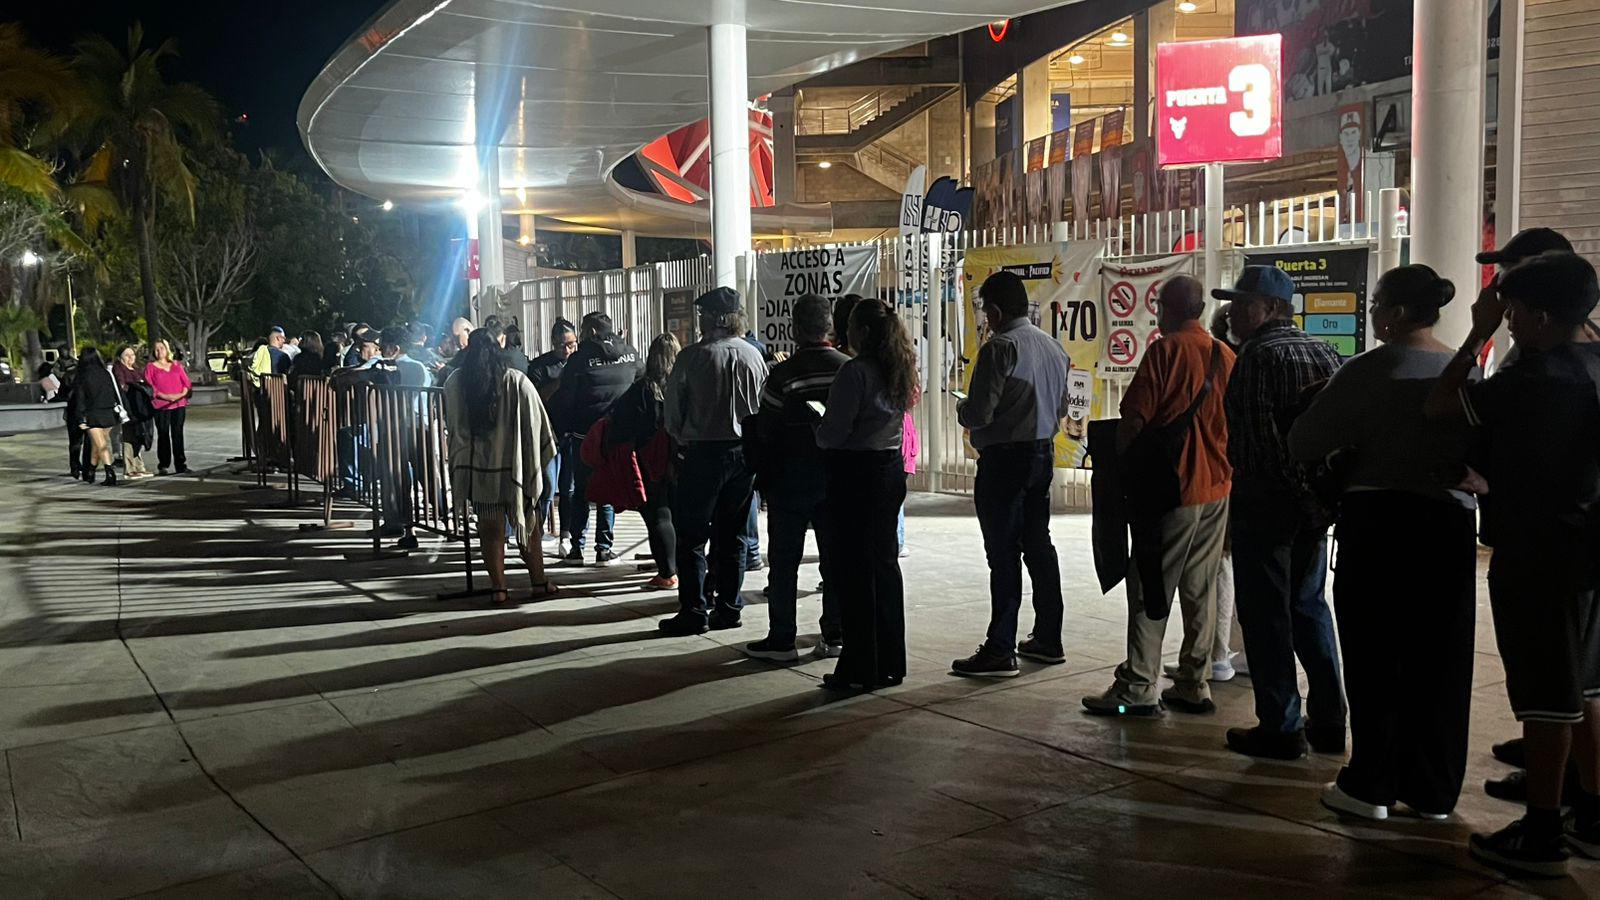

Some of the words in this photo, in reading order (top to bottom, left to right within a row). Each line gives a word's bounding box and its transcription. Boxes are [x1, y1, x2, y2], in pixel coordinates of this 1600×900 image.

[1166, 86, 1227, 107] PUERTA
[1228, 63, 1272, 137] 3
[780, 249, 830, 271] ACCESO
[834, 248, 846, 267] A
[1275, 260, 1317, 272] Puerta
[1318, 258, 1327, 270] 3
[784, 271, 843, 296] ZONAS
[1050, 300, 1097, 342] 1x70
[1322, 318, 1338, 329] Oro
